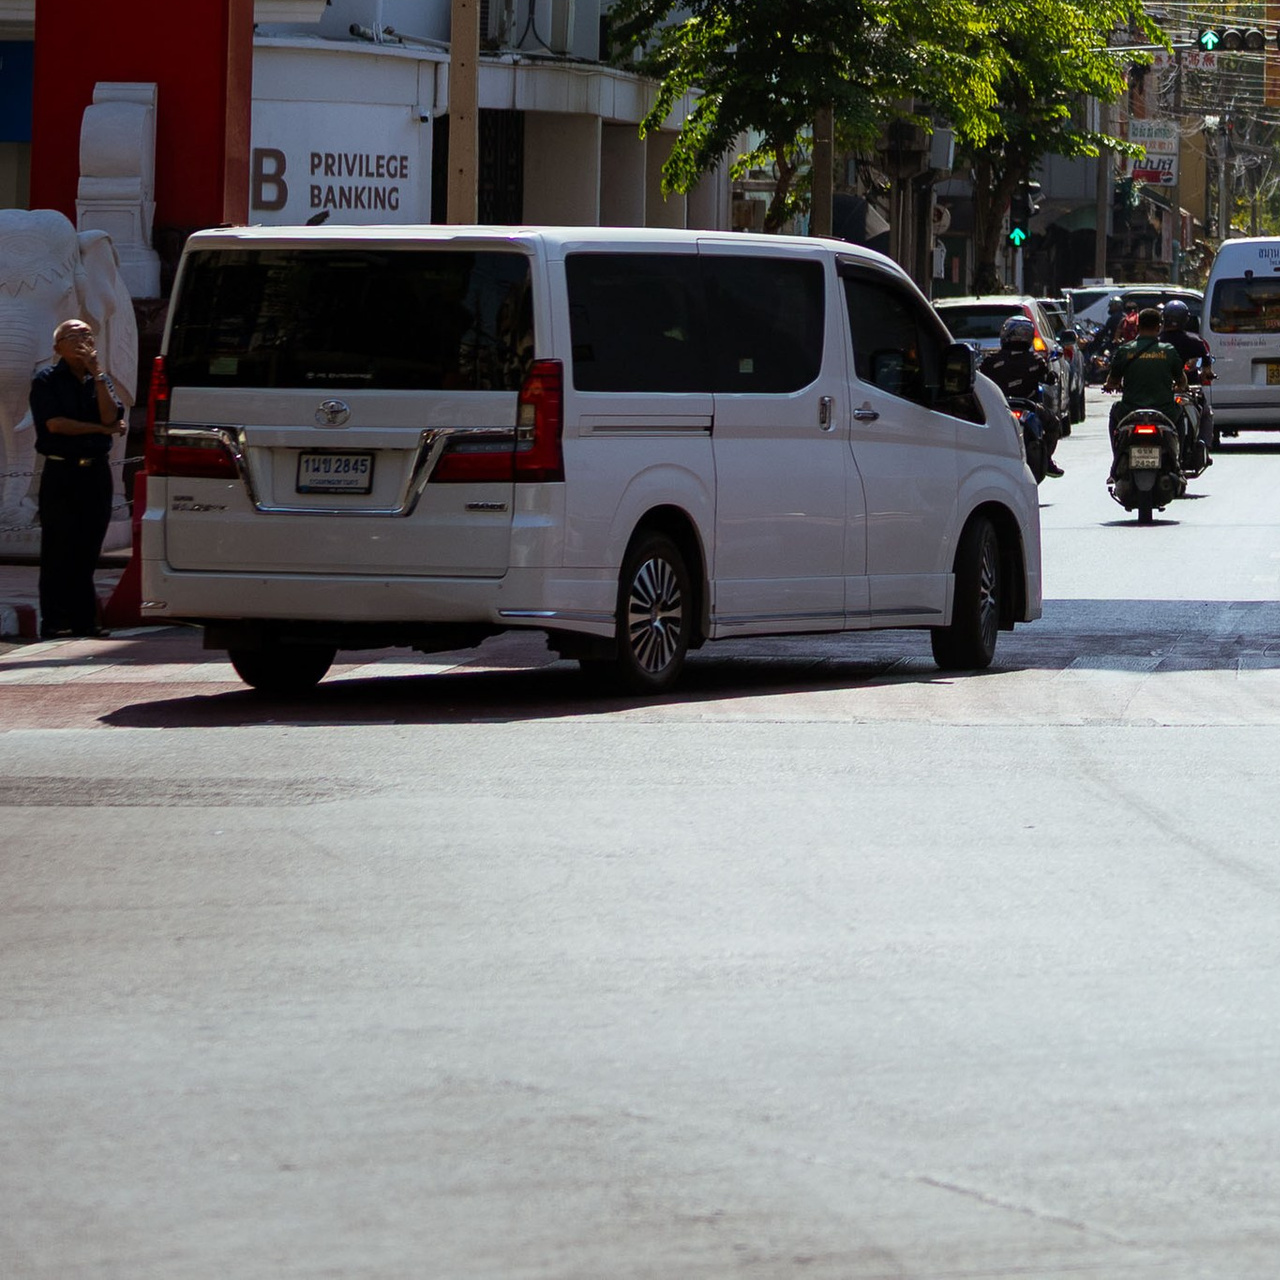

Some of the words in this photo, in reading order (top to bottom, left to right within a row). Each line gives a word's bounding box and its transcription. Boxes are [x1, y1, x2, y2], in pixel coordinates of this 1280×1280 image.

[310, 152, 409, 179] PRIVILEGE
[310, 184, 399, 211] BANKING
[334, 458, 369, 474] 2845
